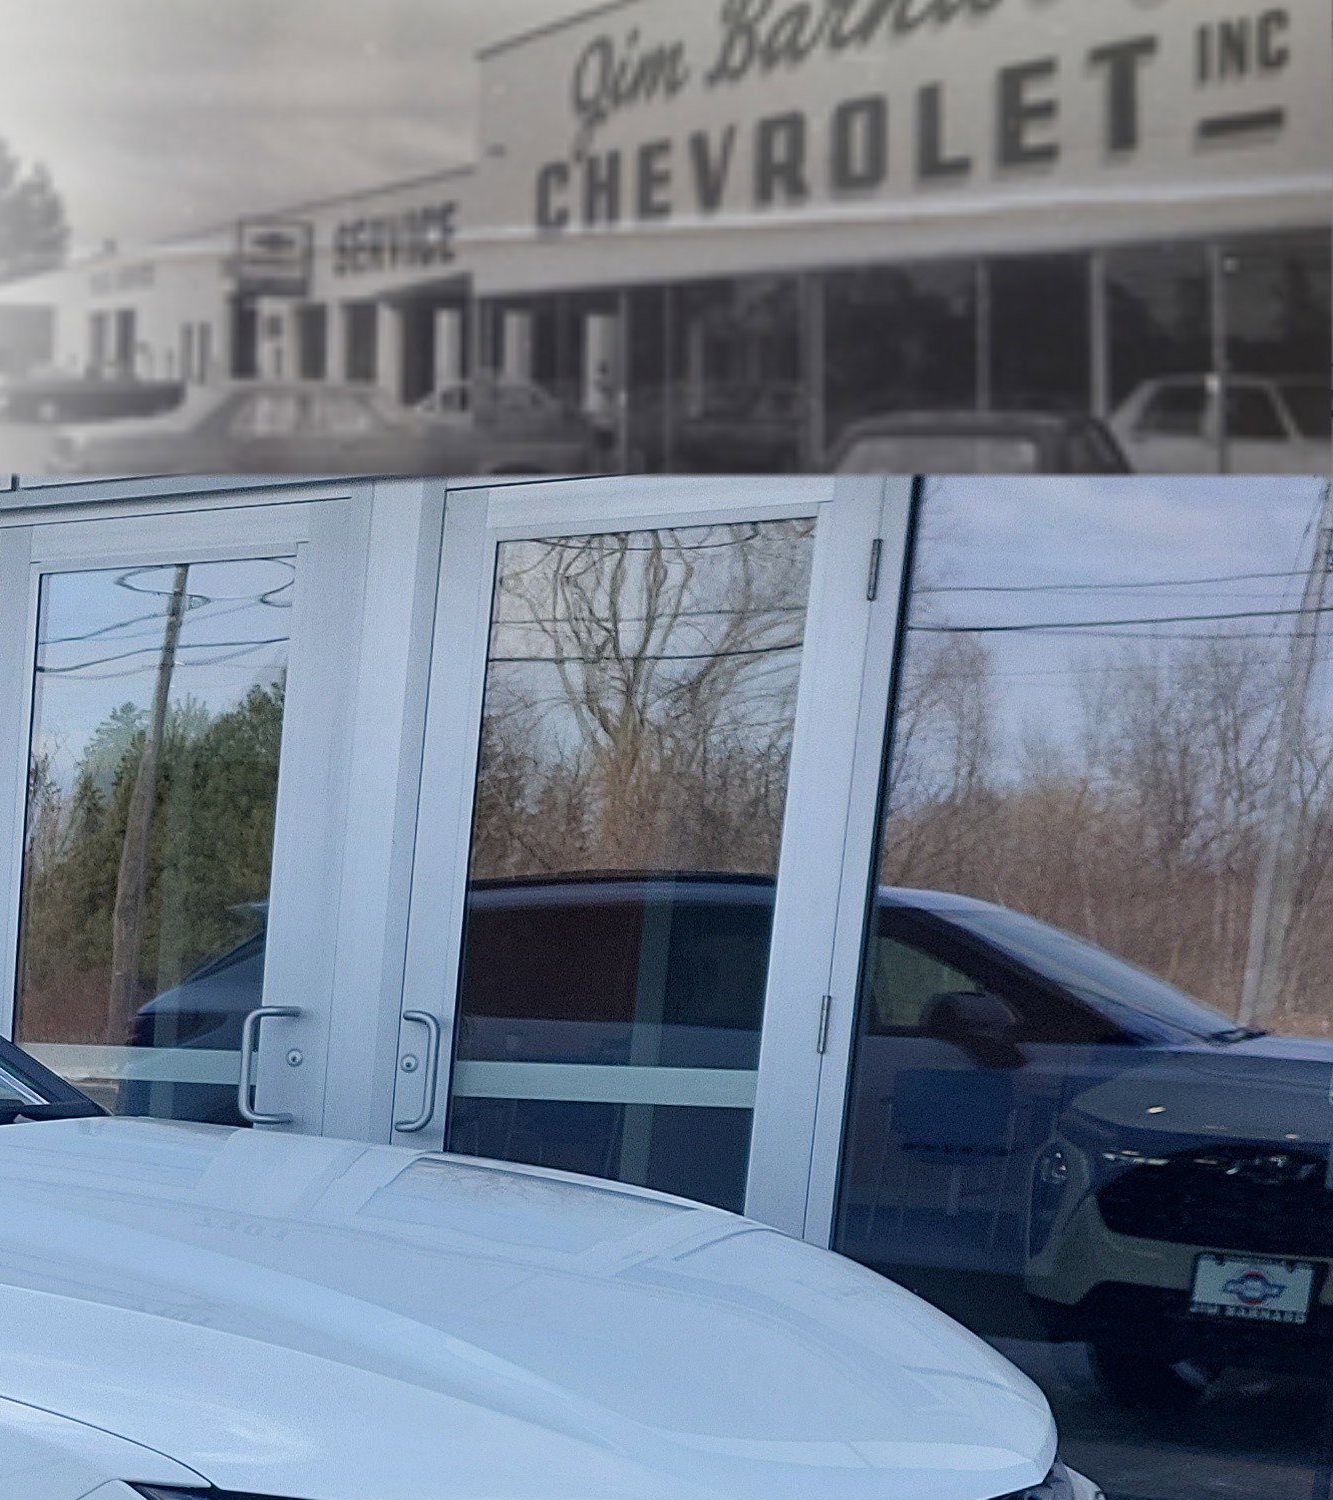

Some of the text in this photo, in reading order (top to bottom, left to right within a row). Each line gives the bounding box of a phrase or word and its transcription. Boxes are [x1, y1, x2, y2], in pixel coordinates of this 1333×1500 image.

[535, 8, 1291, 234] CHEVROLET INC
[571, 27, 690, 137] Jim
[334, 203, 457, 276] SERVICE
